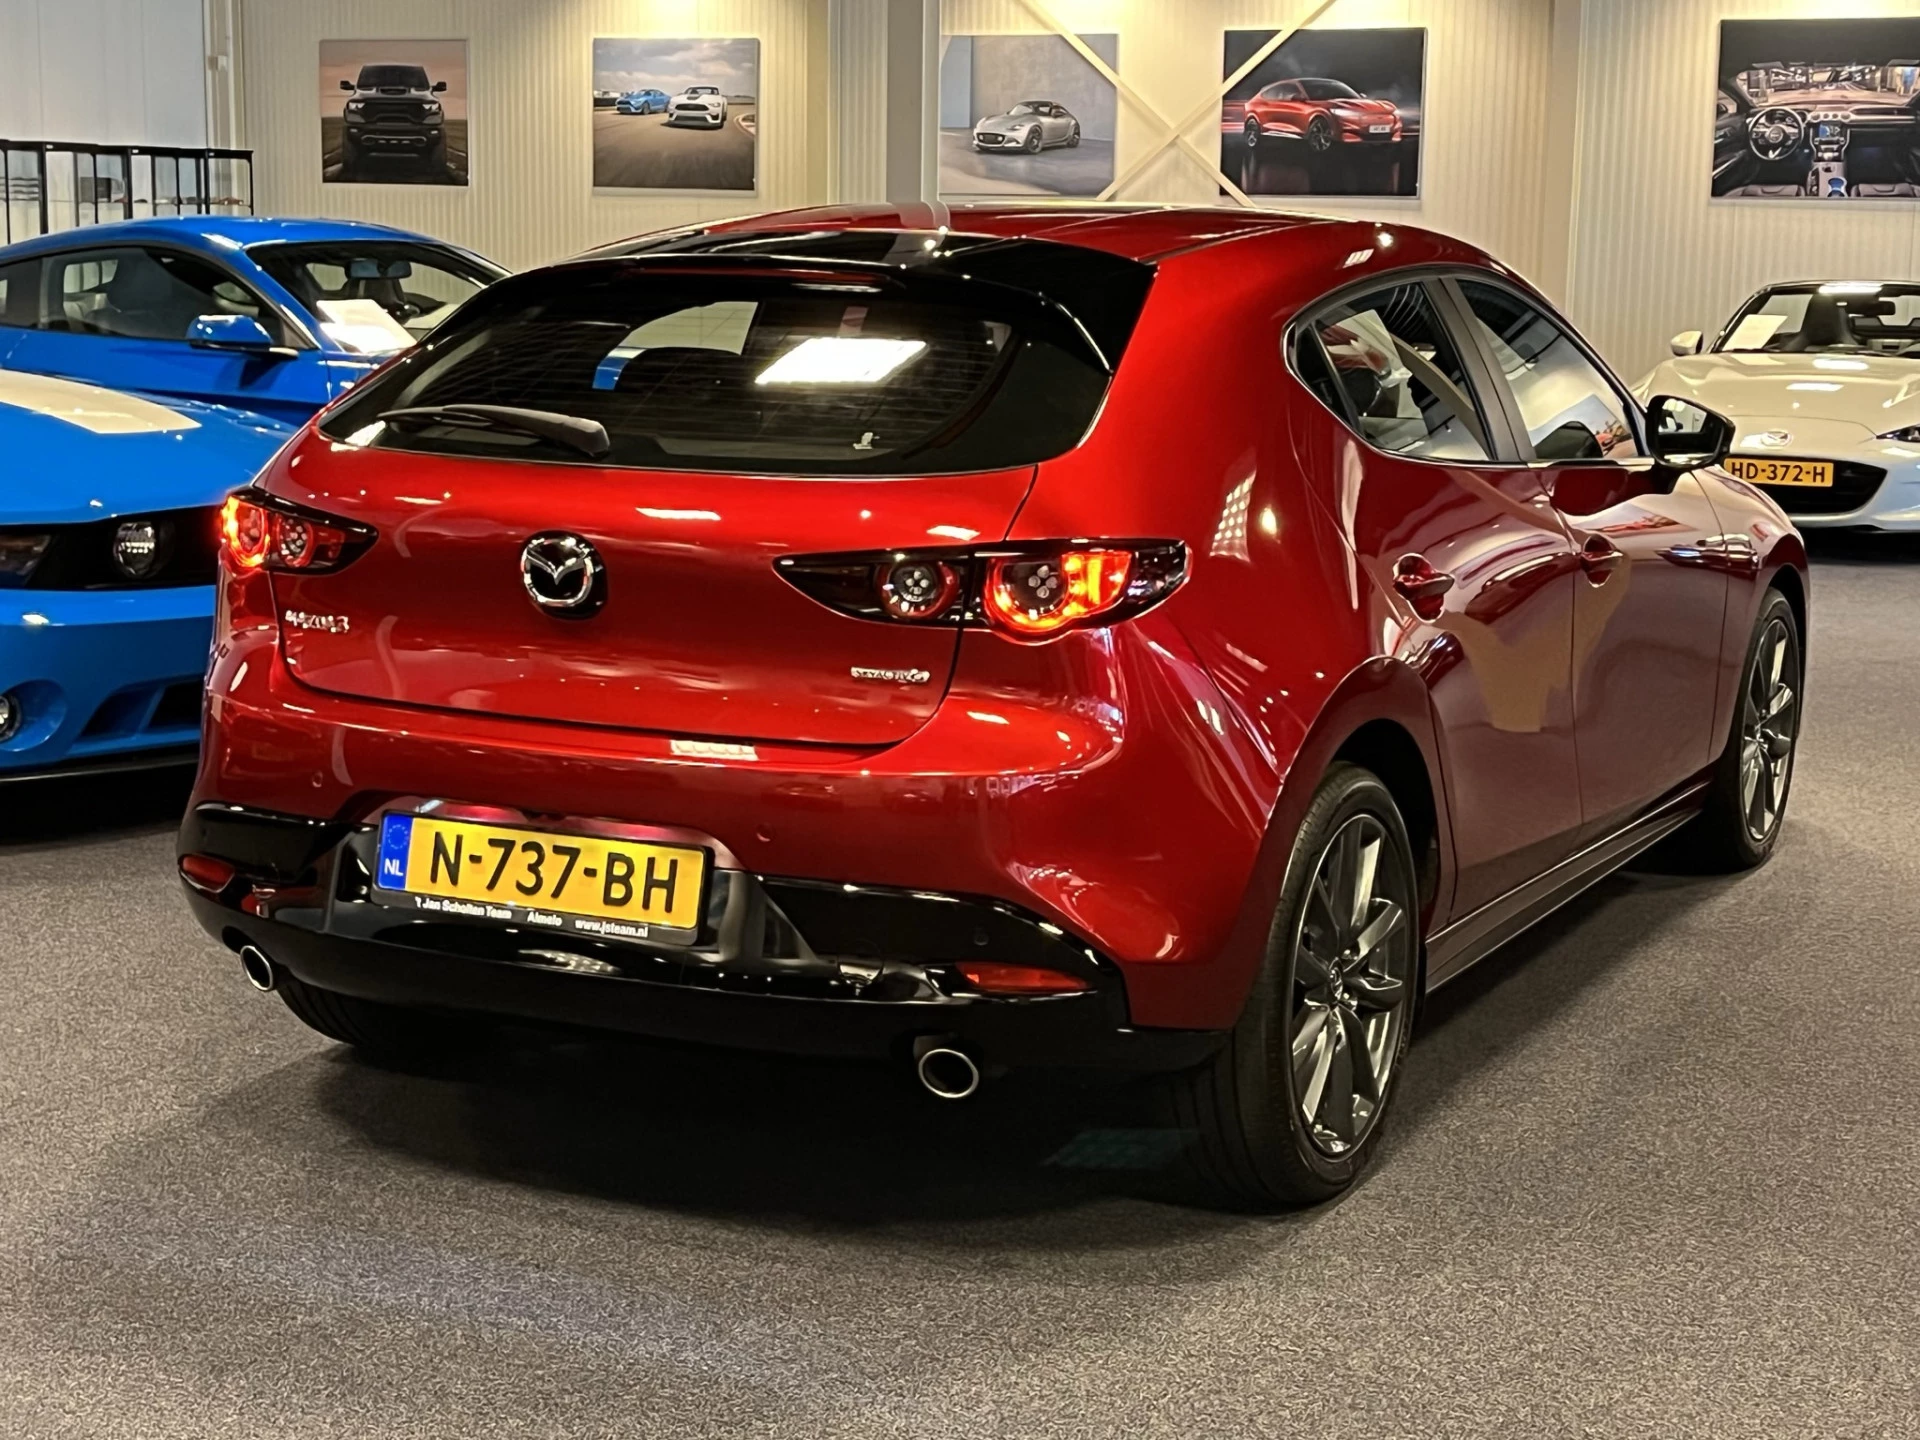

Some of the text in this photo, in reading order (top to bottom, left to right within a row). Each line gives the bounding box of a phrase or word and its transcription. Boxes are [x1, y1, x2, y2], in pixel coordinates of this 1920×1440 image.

[1731, 462, 1825, 483] HD-372-H
[384, 858, 404, 876] NL
[430, 831, 679, 913] N-737-BH
[422, 898, 441, 910] Jan
[442, 899, 485, 916] Scholten
[486, 905, 512, 919] Team
[527, 911, 562, 926] Almelo
[575, 920, 649, 938] www.jsteam.nl
